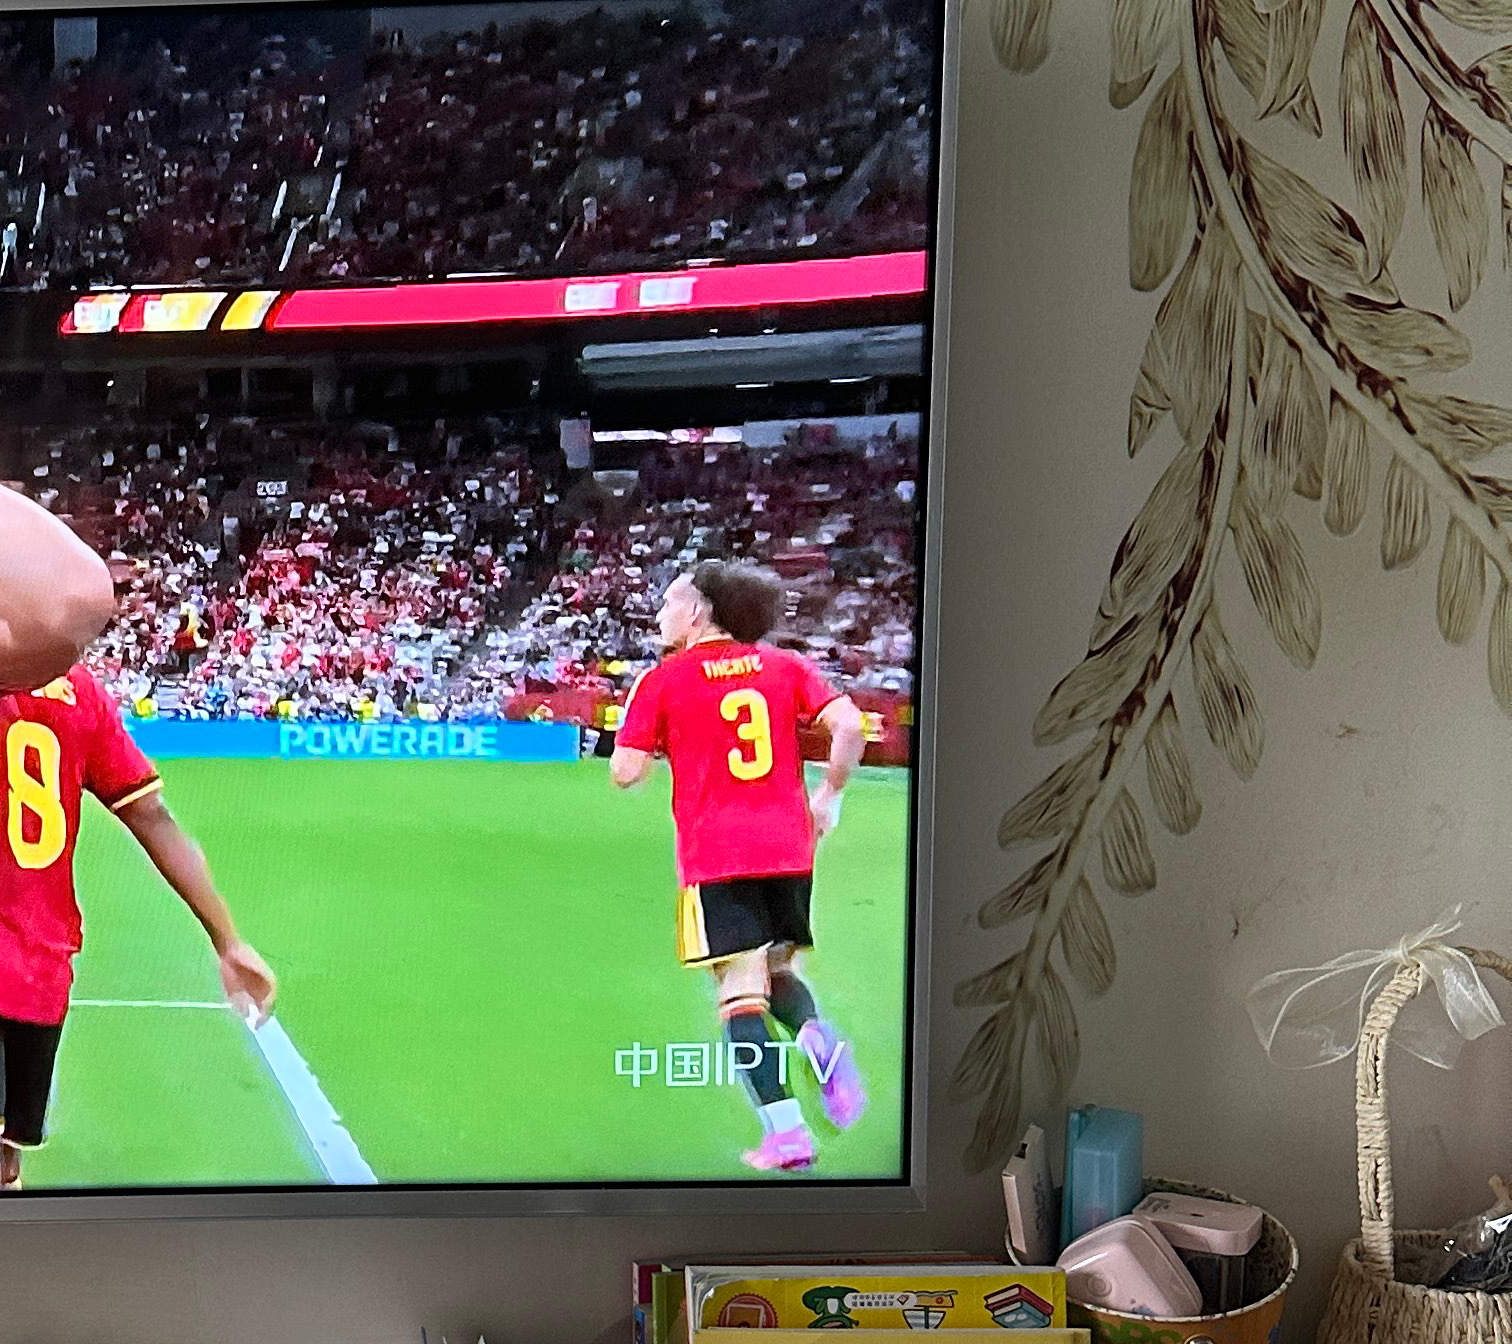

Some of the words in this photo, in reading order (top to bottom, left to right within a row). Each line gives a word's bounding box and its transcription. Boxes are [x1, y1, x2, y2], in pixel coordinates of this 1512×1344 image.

[279, 722, 499, 757] POWERADE
[719, 688, 775, 782] 3
[6, 719, 67, 870] 8
